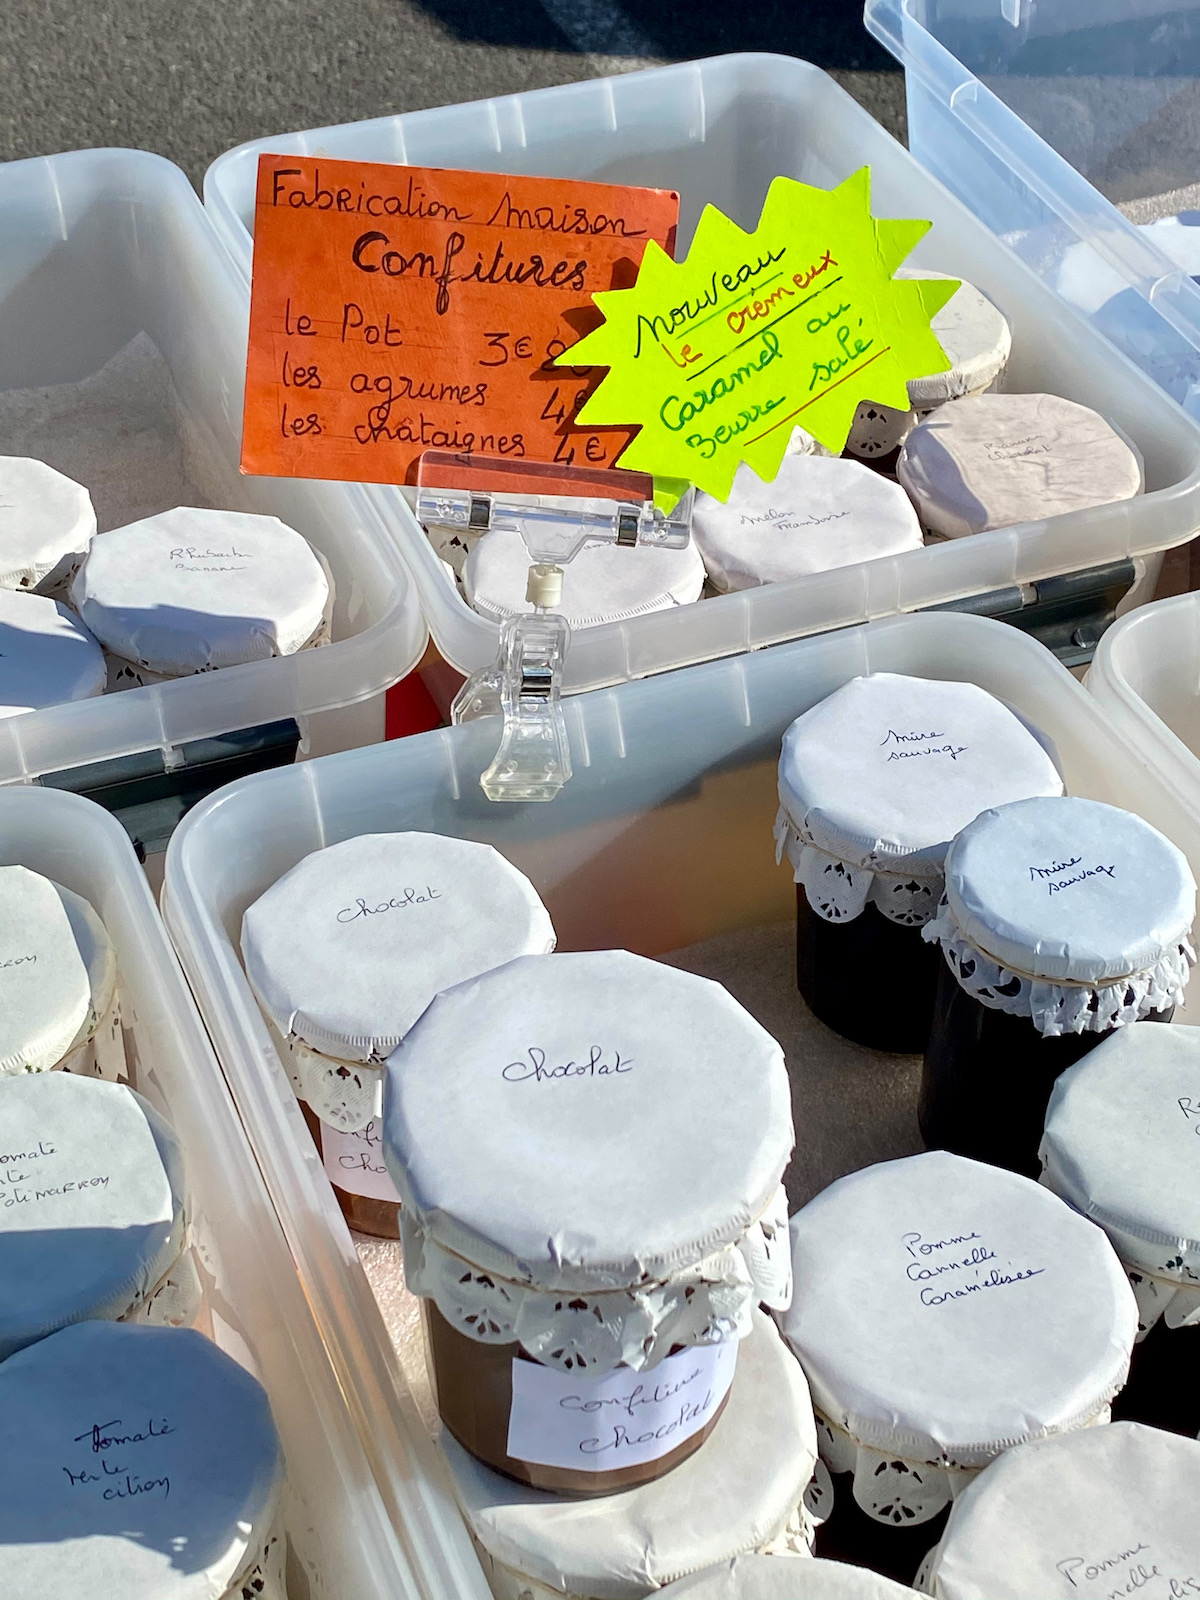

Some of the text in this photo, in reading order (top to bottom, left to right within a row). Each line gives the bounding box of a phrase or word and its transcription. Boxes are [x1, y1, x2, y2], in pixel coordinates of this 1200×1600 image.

[272, 169, 474, 221] Fabrication
[352, 231, 586, 316] Confitures
[285, 298, 318, 337] le
[341, 303, 403, 347] Pot
[282, 351, 321, 389] les
[351, 373, 488, 409] agrumes
[659, 303, 851, 432] Caramel au
[808, 318, 874, 392] salé
[281, 404, 320, 438] les
[901, 1232, 982, 1258] Pomme
[906, 1247, 998, 1282] Cannelle
[1056, 1543, 1150, 1588] Pomme
